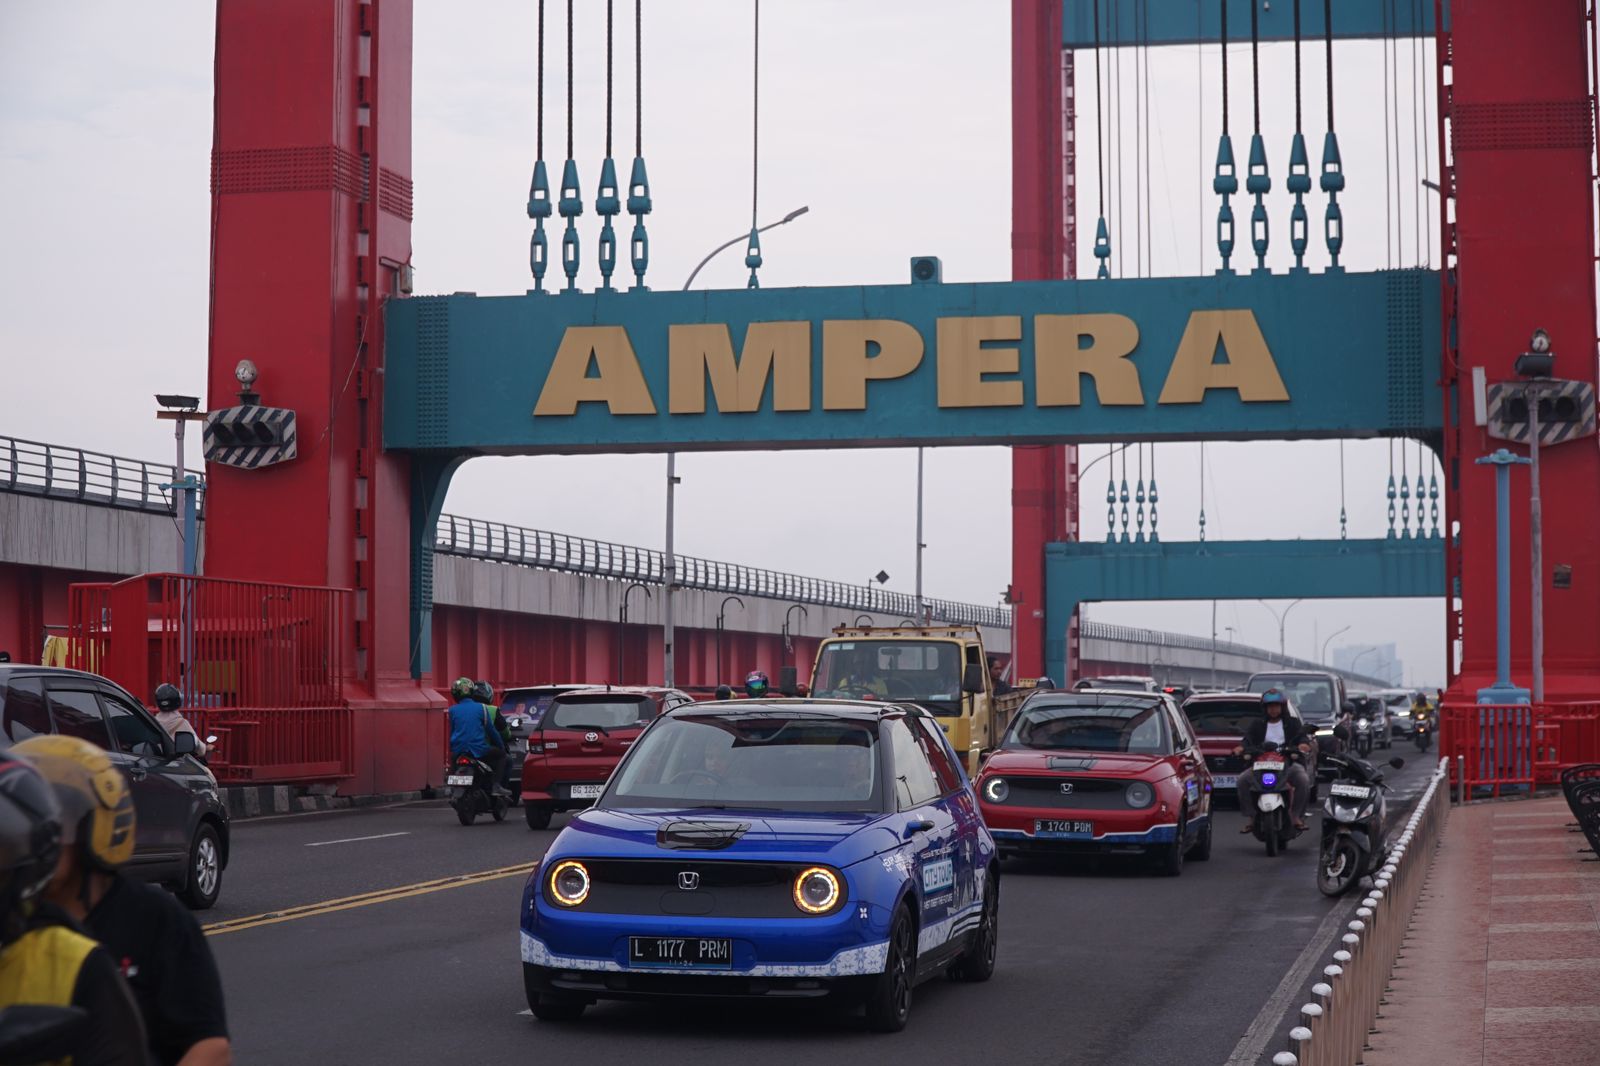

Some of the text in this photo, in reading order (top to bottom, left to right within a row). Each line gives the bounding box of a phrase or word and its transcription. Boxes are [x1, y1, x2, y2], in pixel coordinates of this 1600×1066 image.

[533, 308, 1291, 416] AMPERA
[1035, 820, 1042, 831] B
[634, 938, 728, 959] L 1177 PRM
